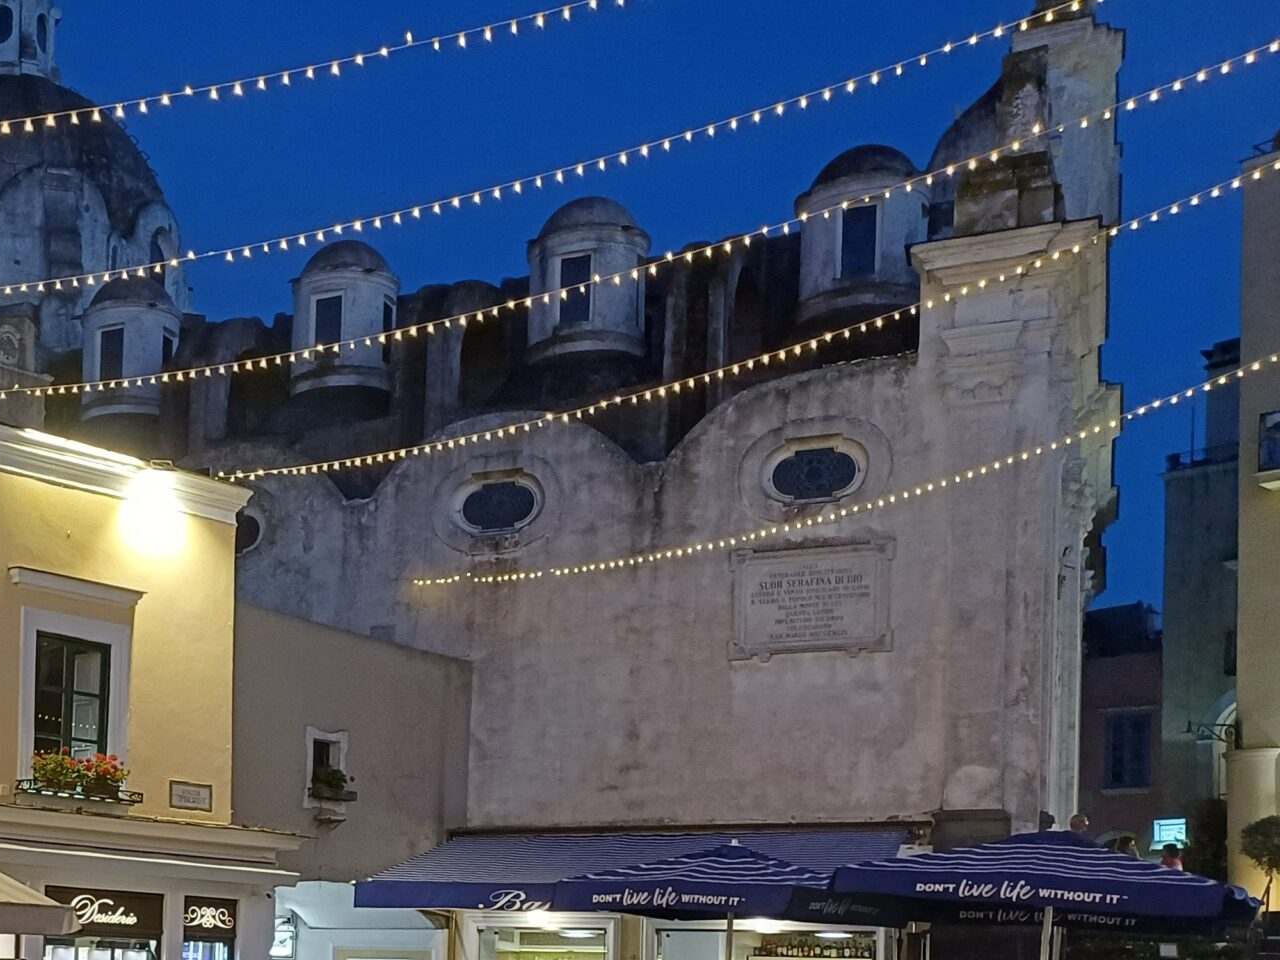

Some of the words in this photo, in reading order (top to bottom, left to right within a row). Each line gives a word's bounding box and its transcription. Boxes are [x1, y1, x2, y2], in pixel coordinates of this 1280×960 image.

[759, 581, 782, 590] SUOR
[786, 577, 831, 588] SERAFINA
[592, 894, 622, 903] DON'T
[622, 888, 651, 906] live
[653, 886, 678, 908] life
[681, 894, 727, 904] WITHOUT
[729, 897, 740, 906] IT
[916, 883, 956, 892] DON'T
[958, 879, 997, 897] live
[1000, 880, 1035, 902] life
[1039, 888, 1103, 903] WITHOUT
[1106, 894, 1120, 904] IT
[71, 894, 138, 925] Desiderio
[1067, 913, 1121, 925] WITHOUT
